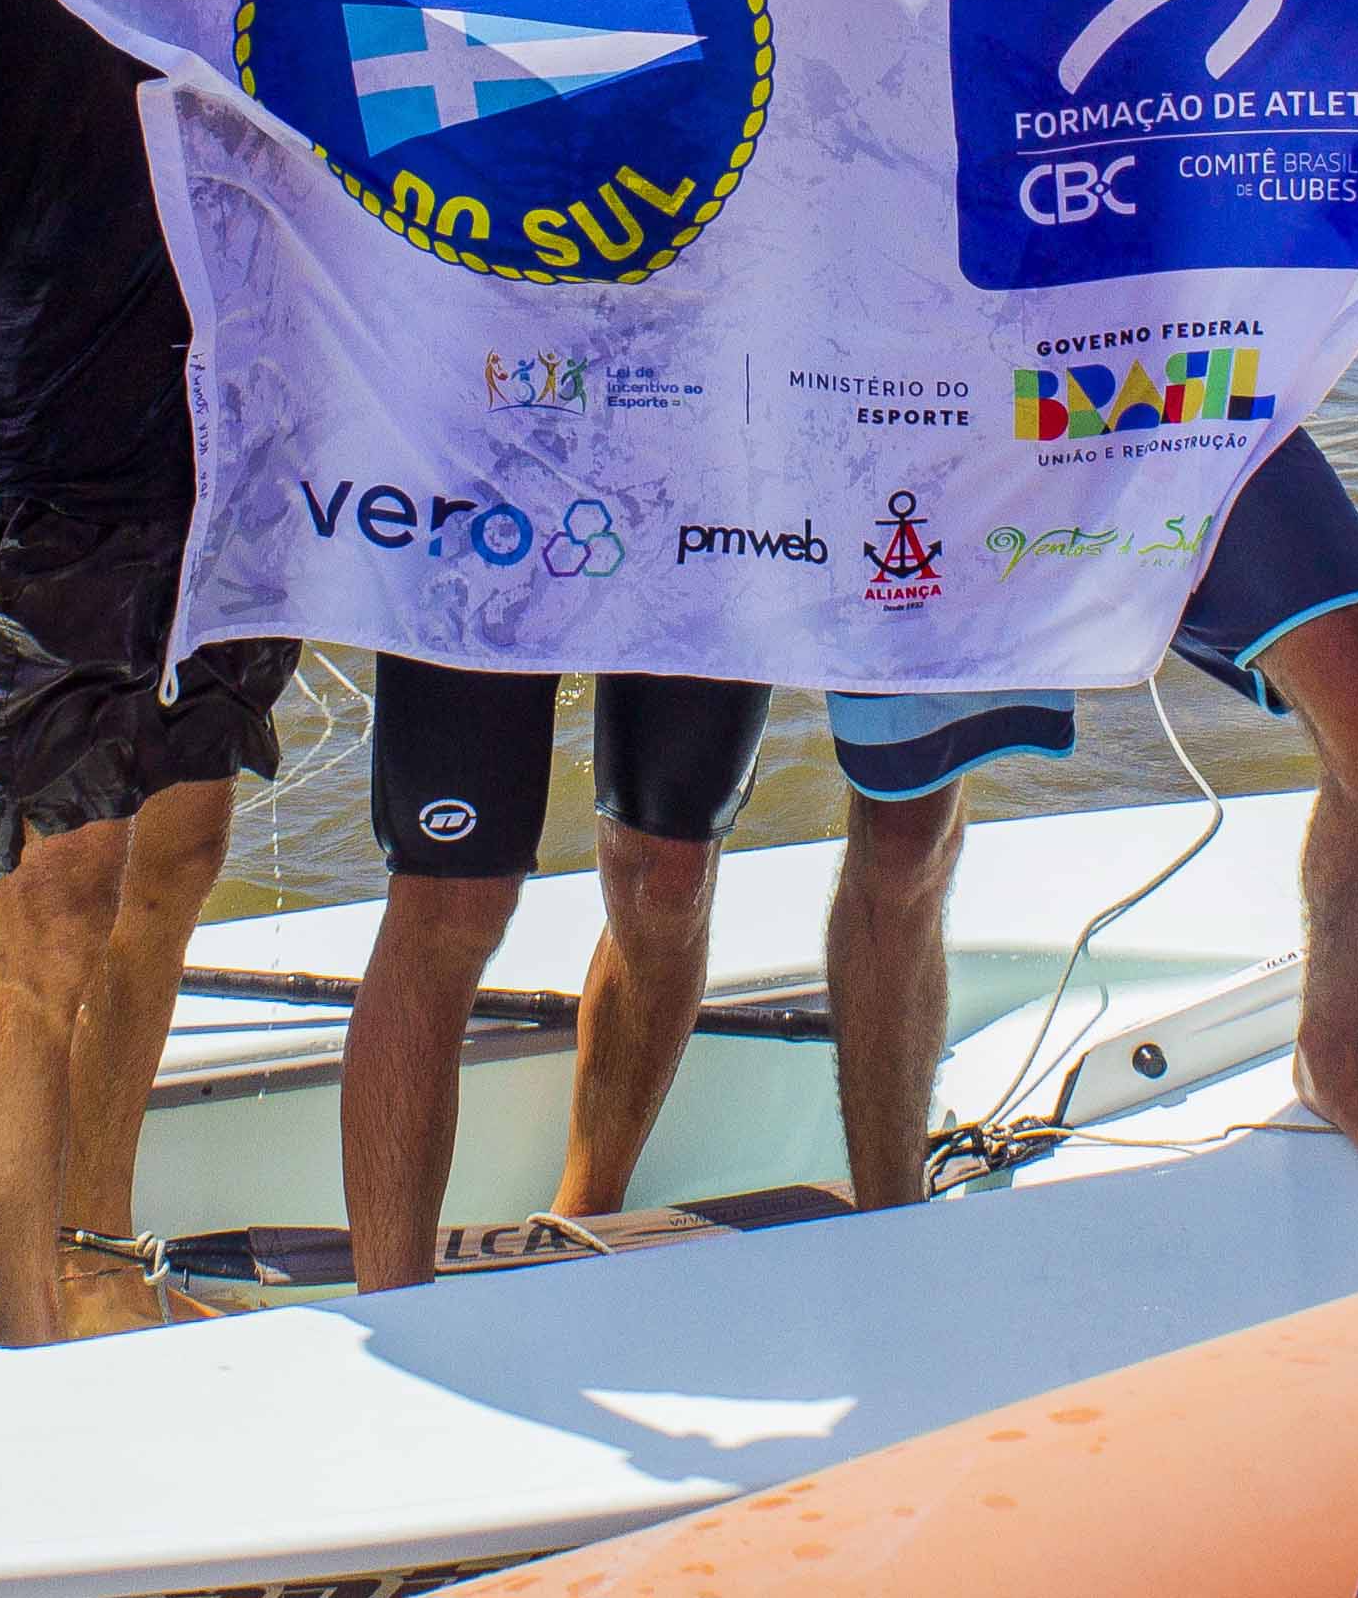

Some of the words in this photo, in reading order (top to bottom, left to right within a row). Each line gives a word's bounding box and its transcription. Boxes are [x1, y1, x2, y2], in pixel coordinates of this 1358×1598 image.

[1014, 92, 1204, 140] FORMAÇÃO
[1213, 91, 1258, 120] DE
[1179, 147, 1275, 178] COMITÊ
[1019, 155, 1136, 225] CBC
[1236, 184, 1253, 198] DE
[1258, 178, 1357, 202] CLUBES
[522, 165, 696, 268] SUL
[1037, 327, 1151, 356] GOVERNO
[1162, 320, 1265, 340] FEDERAL
[606, 366, 630, 379] Lei
[635, 366, 654, 379] de
[789, 370, 924, 397] MINISTÉRIO
[936, 381, 969, 398] DO
[607, 380, 679, 395] Incentivo
[683, 383, 704, 395] ao
[1013, 348, 1276, 442] BRASIL
[607, 397, 669, 410] Esporte
[857, 407, 970, 426] ESPORTE
[1038, 450, 1097, 467] UNIÃO
[1105, 447, 1114, 459] E
[300, 480, 534, 567] vero
[676, 518, 829, 565] pmweb
[864, 584, 942, 601] ALIANÇA
